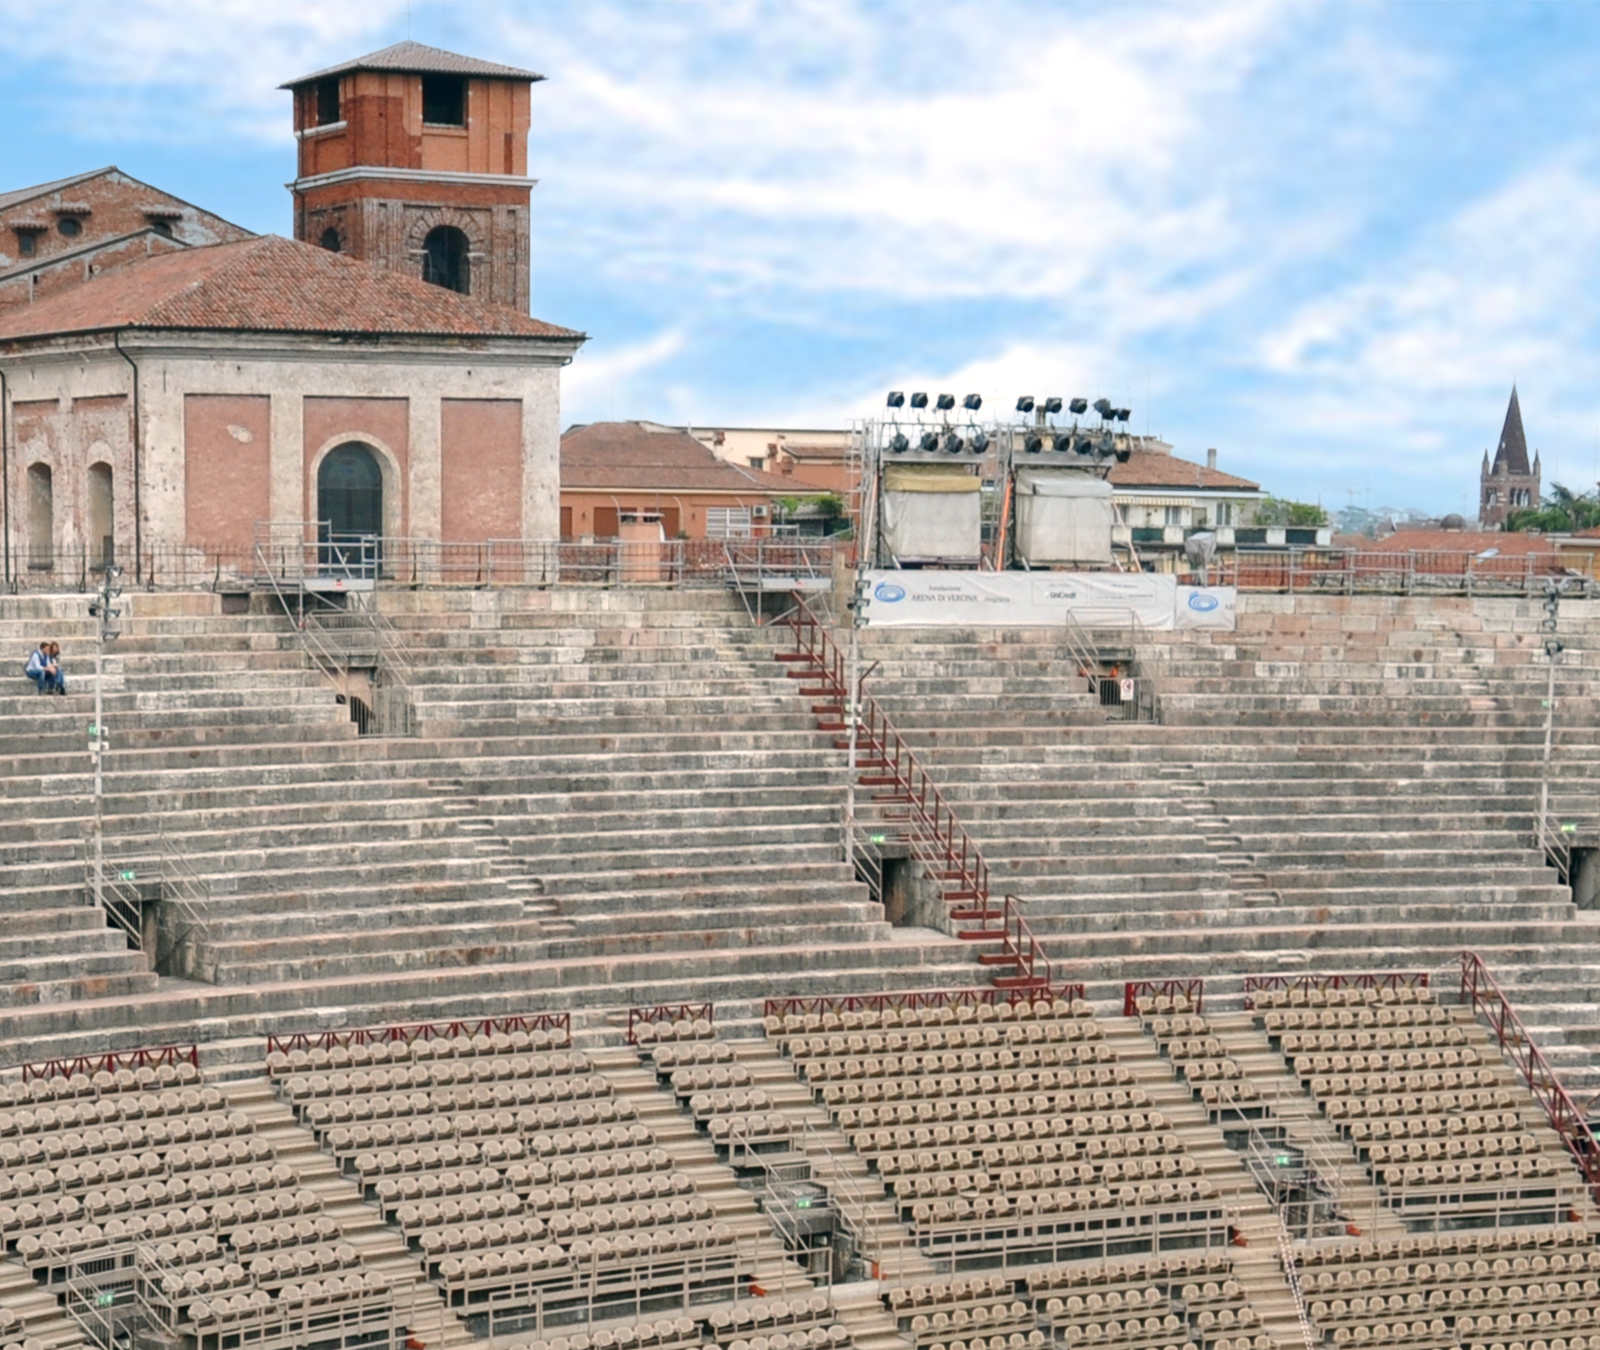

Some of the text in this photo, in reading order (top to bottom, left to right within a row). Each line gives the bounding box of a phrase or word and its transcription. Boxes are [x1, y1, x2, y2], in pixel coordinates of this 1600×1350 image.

[911, 594, 936, 602] ARENA
[938, 594, 946, 602] DI
[947, 594, 978, 602] VERONA
